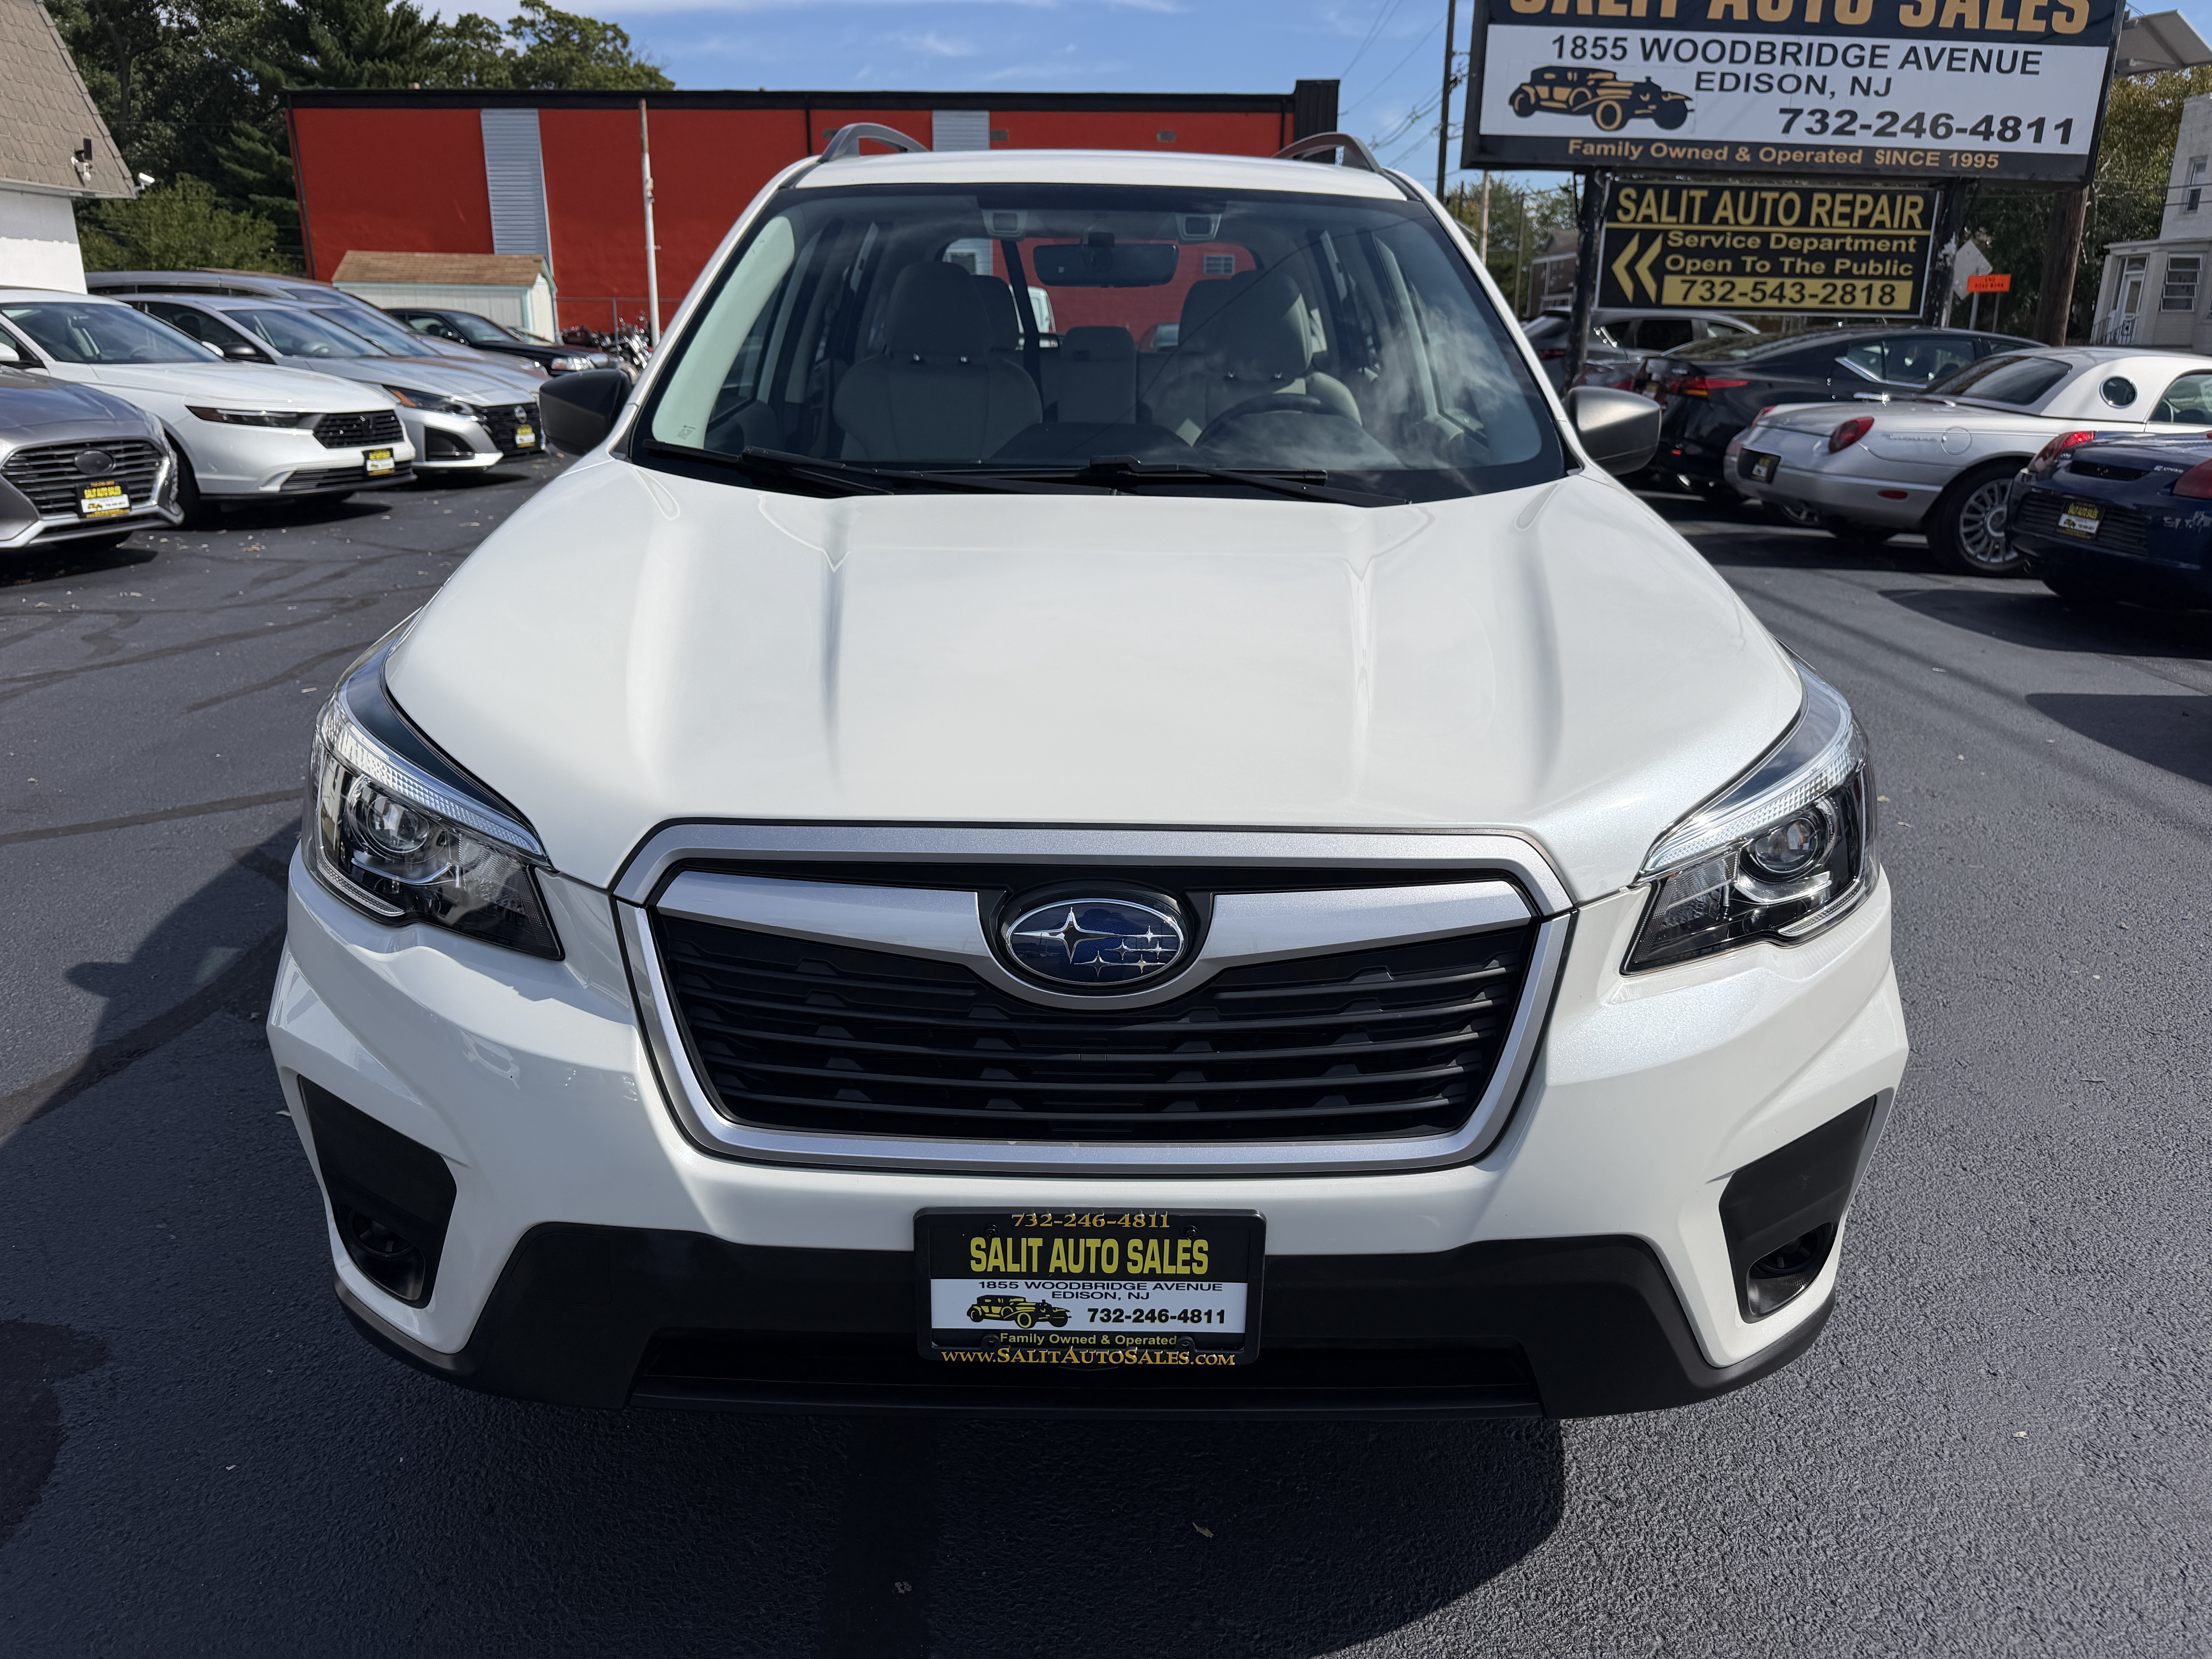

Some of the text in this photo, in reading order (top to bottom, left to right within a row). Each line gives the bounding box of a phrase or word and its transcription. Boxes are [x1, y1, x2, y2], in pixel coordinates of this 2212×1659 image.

[1553, 35, 2042, 75] 1855 WOODBRIDGE AVENUE
[1695, 72, 1891, 99] EDISON, NJ
[1779, 108, 2073, 144] 732-246-4811
[1570, 140, 1999, 168] Family Owned & Operated SINCE 1995
[1616, 188, 1923, 230] SALIT AUTO REPAIR
[1667, 231, 1916, 254] Service Department
[1666, 255, 1913, 276] Open To The Public
[1681, 280, 1895, 306] 732-543-2818
[1012, 1214, 1170, 1228] 732-246-4811
[971, 1238, 1208, 1274] SALIT AUTO SALES
[1025, 1282, 1147, 1290] WOODBRIDGE
[1052, 1291, 1121, 1300] EDISON,
[1087, 1308, 1224, 1323] 732-246-4811
[1001, 1333, 1177, 1346] Family Owned & Operated
